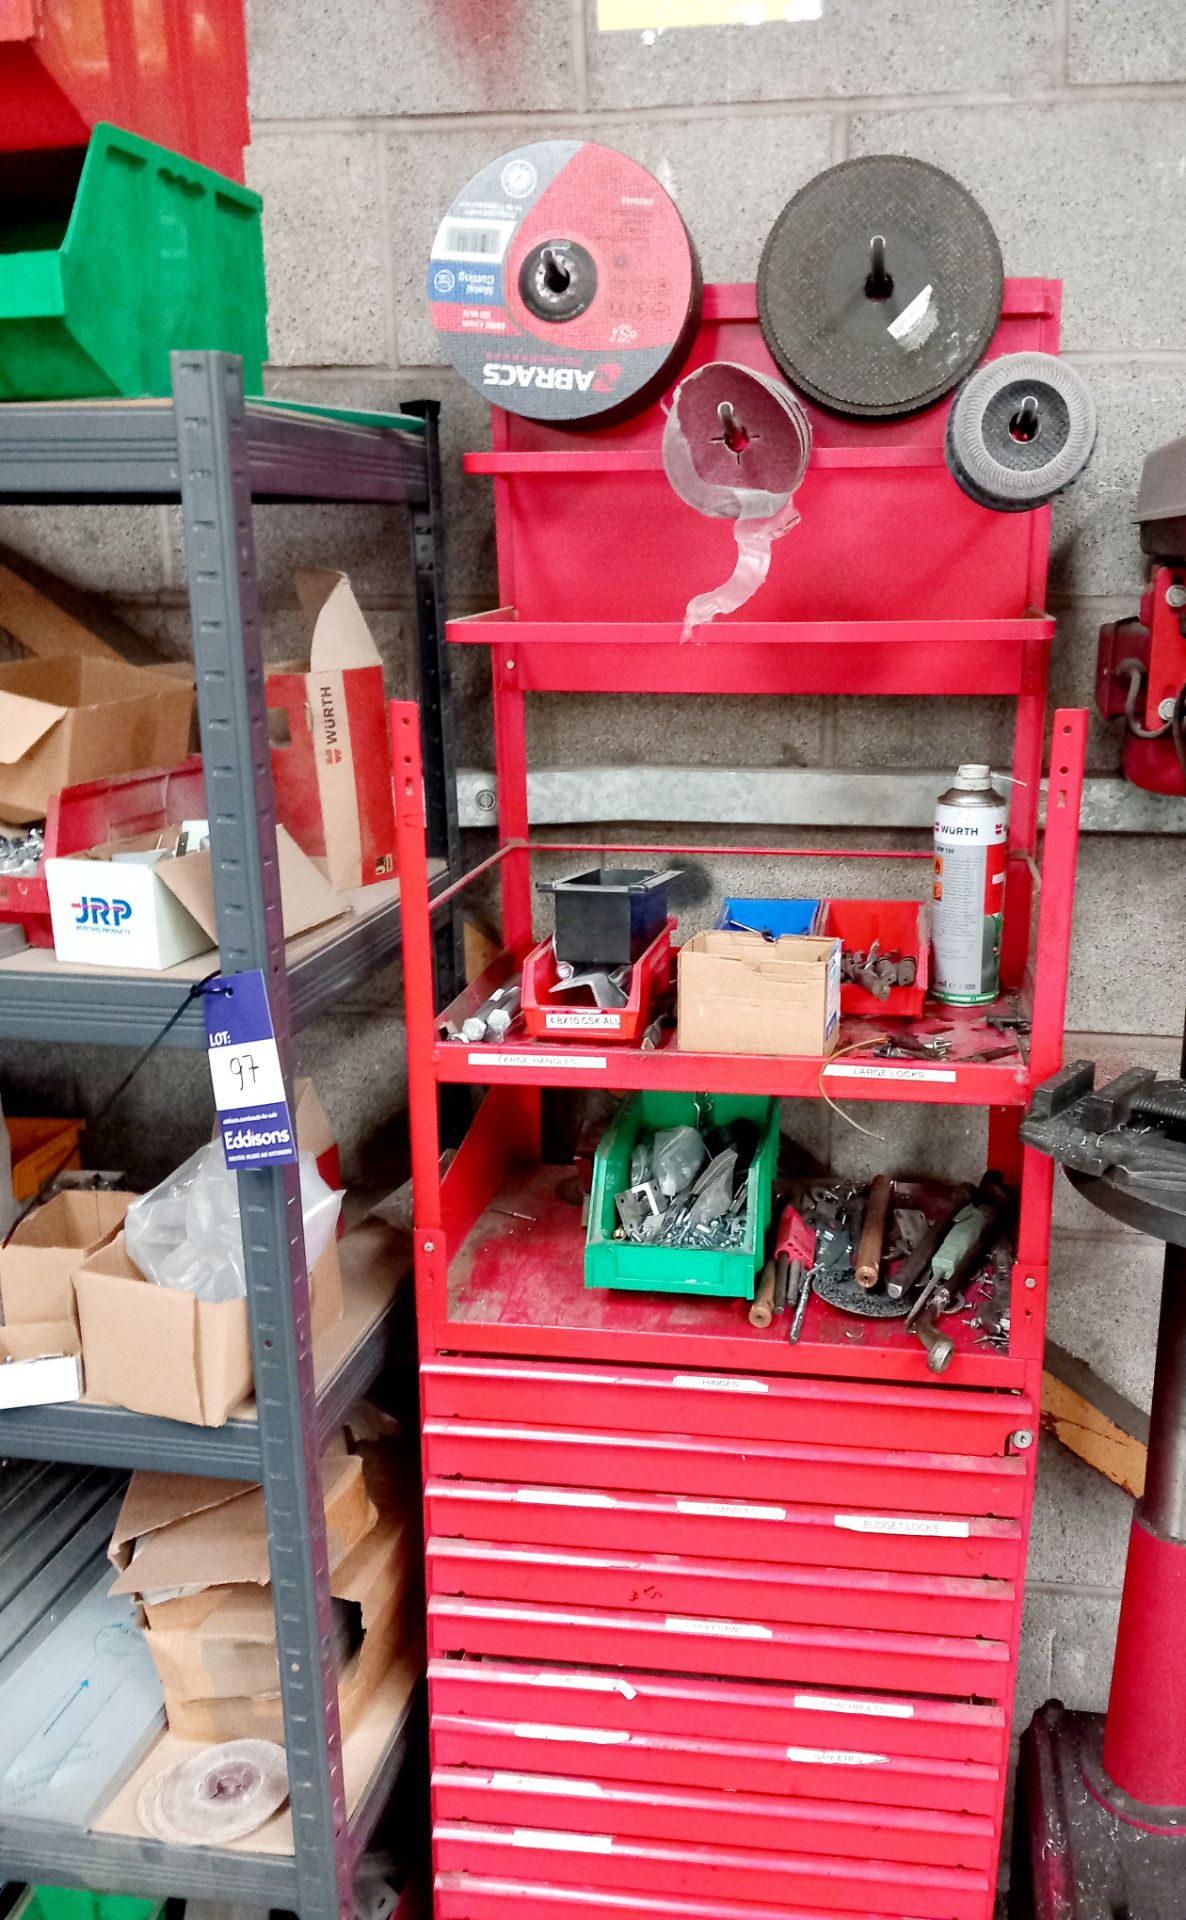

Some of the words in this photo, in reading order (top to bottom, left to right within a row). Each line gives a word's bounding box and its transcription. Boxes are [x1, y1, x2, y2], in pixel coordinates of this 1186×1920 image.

[458, 271, 495, 285] Cutting
[483, 363, 595, 392] ABRACS
[320, 686, 338, 745] WÜRTH
[940, 825, 979, 836] WÜRTH
[75, 896, 132, 926] JRP
[582, 1016, 601, 1025] CSK
[209, 1031, 231, 1047] LOT:
[230, 1054, 259, 1091] 97
[853, 1068, 887, 1076] LARGE
[890, 1070, 925, 1079] LOCKS
[224, 1129, 290, 1150] Eddisons
[864, 1520, 903, 1530] BUDGET
[906, 1522, 940, 1532] LOCKS
